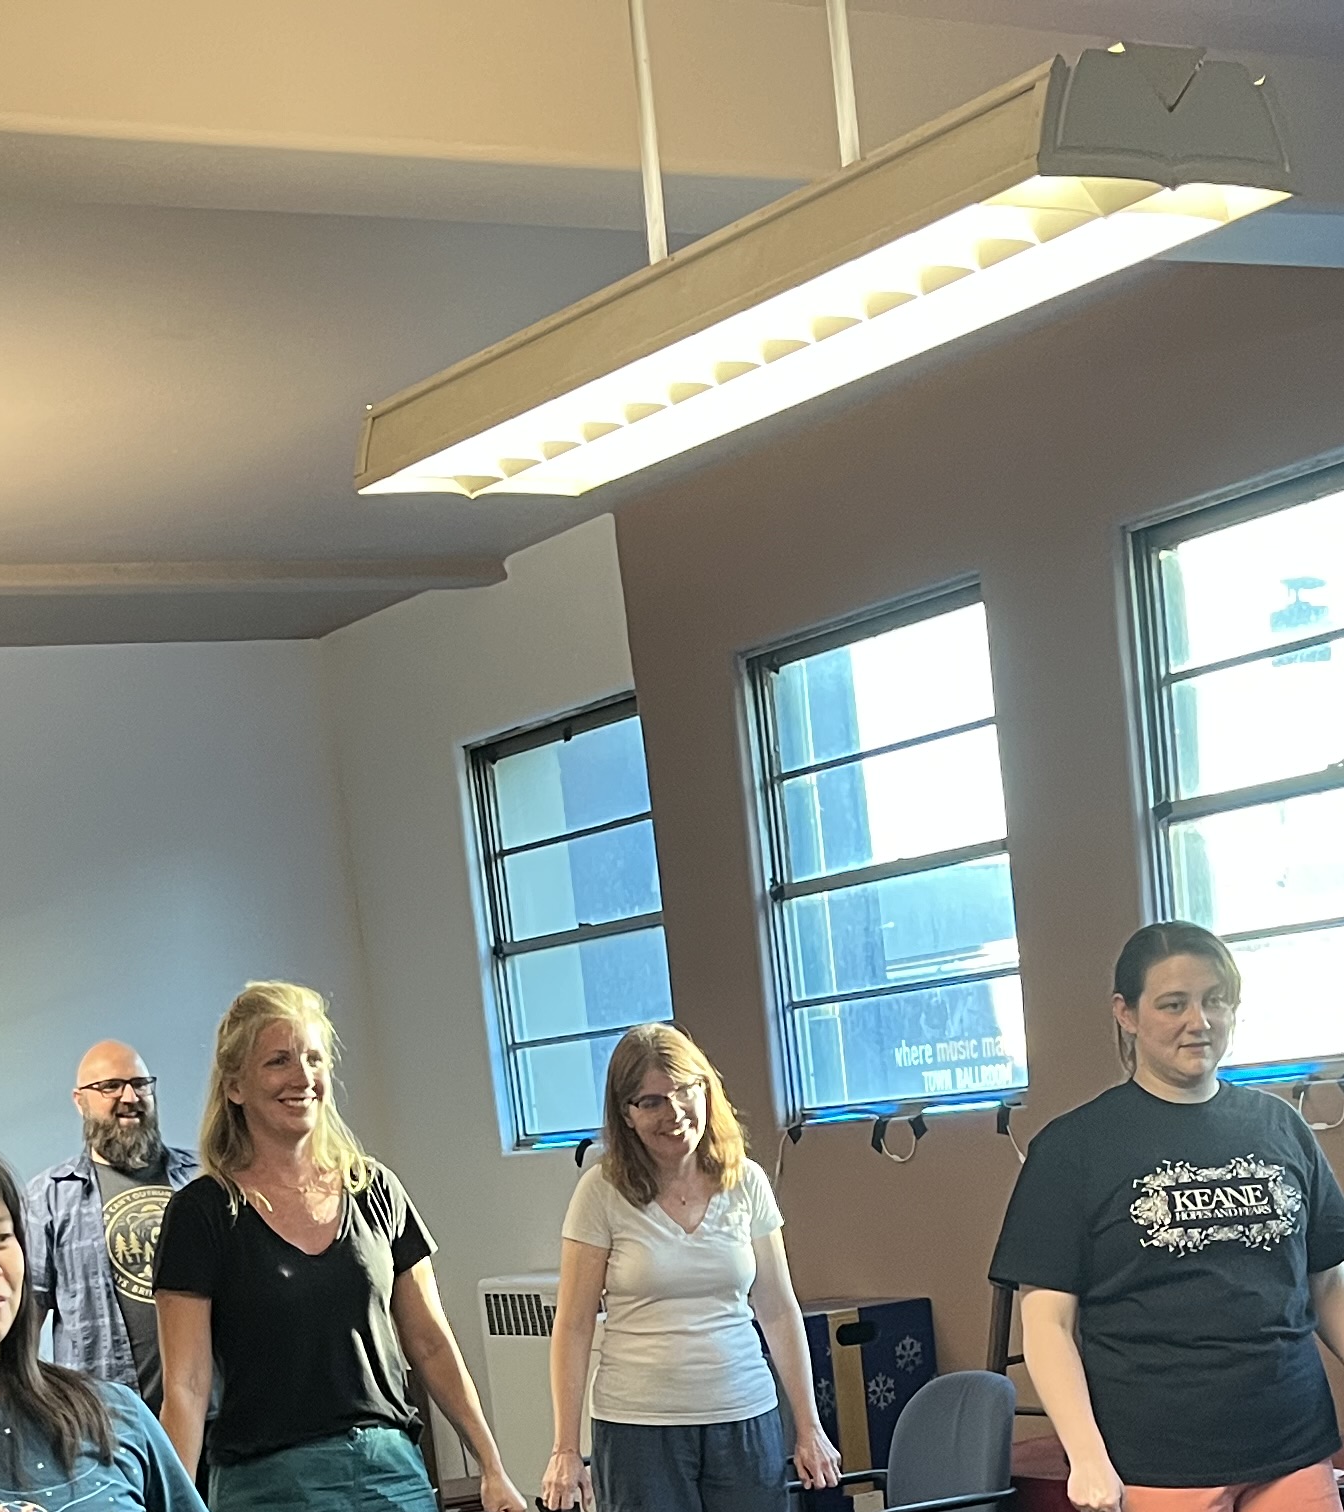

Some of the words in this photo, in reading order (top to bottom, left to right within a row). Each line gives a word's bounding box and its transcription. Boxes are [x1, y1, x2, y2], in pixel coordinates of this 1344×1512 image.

[935, 1038, 978, 1063] music
[921, 1068, 953, 1093] TOWN
[955, 1063, 1013, 1089] BALLROOM
[1171, 1184, 1269, 1212] KEANE
[1175, 1209, 1213, 1222] HOPES
[1214, 1207, 1238, 1218] AND
[1239, 1204, 1272, 1217] FEARS
